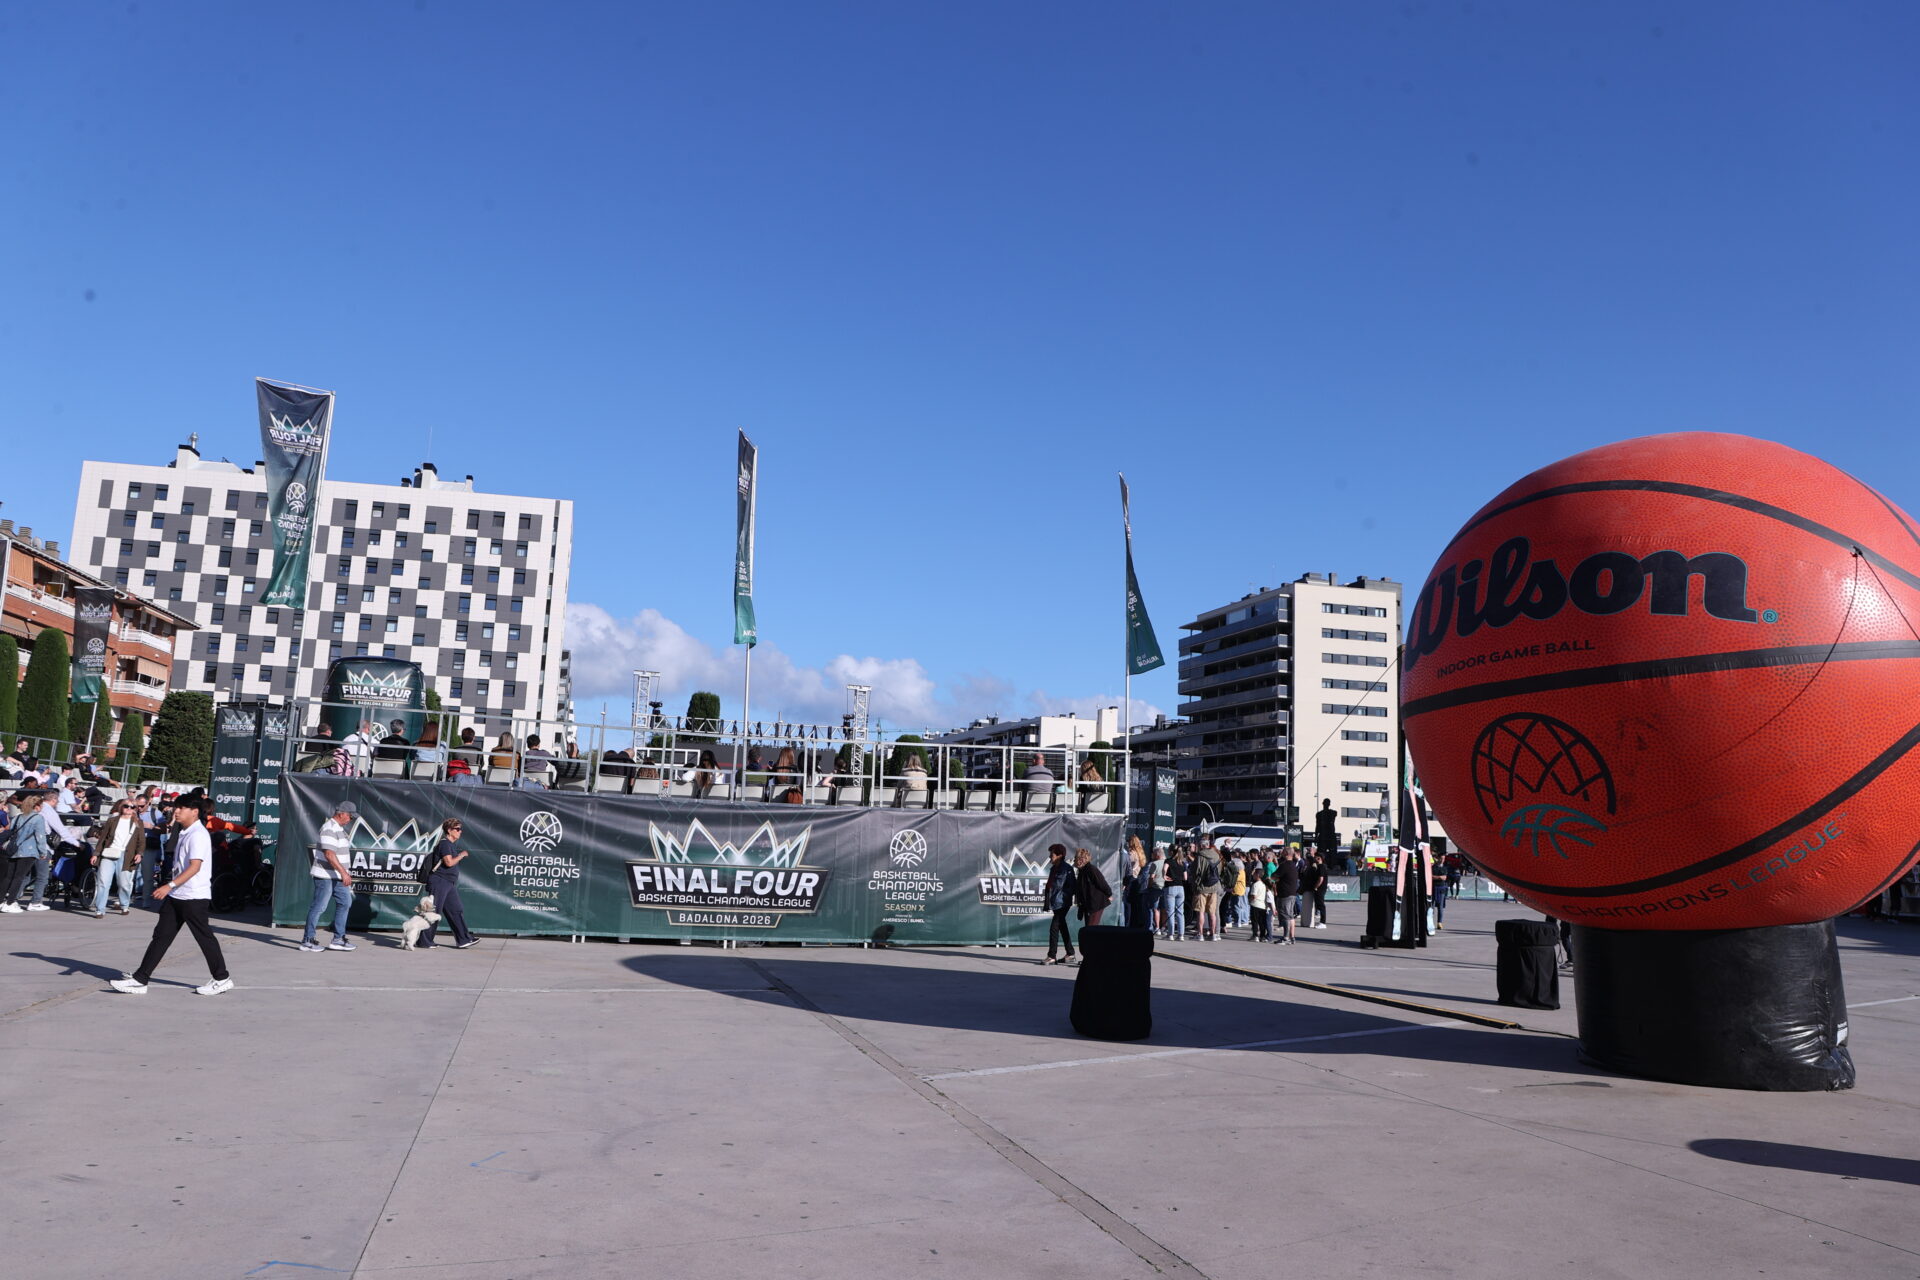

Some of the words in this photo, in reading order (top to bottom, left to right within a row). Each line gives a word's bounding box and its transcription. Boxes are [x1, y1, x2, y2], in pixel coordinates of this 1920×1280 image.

[1405, 536, 1758, 672] Wilson
[1436, 654, 1486, 678] INDOOR
[1490, 645, 1540, 663] GAME
[1545, 640, 1596, 654] BALL
[342, 685, 377, 696] FINAL
[379, 688, 412, 698] FOUR
[265, 726, 279, 734] FINAL
[224, 795, 245, 804] green
[266, 797, 279, 806] gree
[216, 812, 241, 822] Wilson
[500, 854, 576, 867] BASKETBALL
[494, 864, 580, 878] CHAMPIONS
[1562, 884, 1728, 917] CHAMPIONS
[1729, 821, 1844, 890] LEAGUE
[366, 871, 413, 880] CHAMPIONS
[632, 865, 727, 894] FINAL
[734, 870, 819, 896] FOUR
[873, 870, 940, 881] BASKETBALL
[513, 877, 560, 888] LEAGUE
[868, 880, 944, 892] CHAMPIONS
[980, 878, 1035, 894] FINAL
[513, 889, 549, 898] SEASON
[885, 892, 926, 901] LEAGUE
[638, 894, 705, 904] BASKETBALL
[707, 896, 770, 906] CHAMPIONS
[772, 898, 811, 908] LEAGUE
[918, 904, 925, 912] X
[679, 913, 738, 924] BADALONA
[742, 915, 771, 924] 2026
